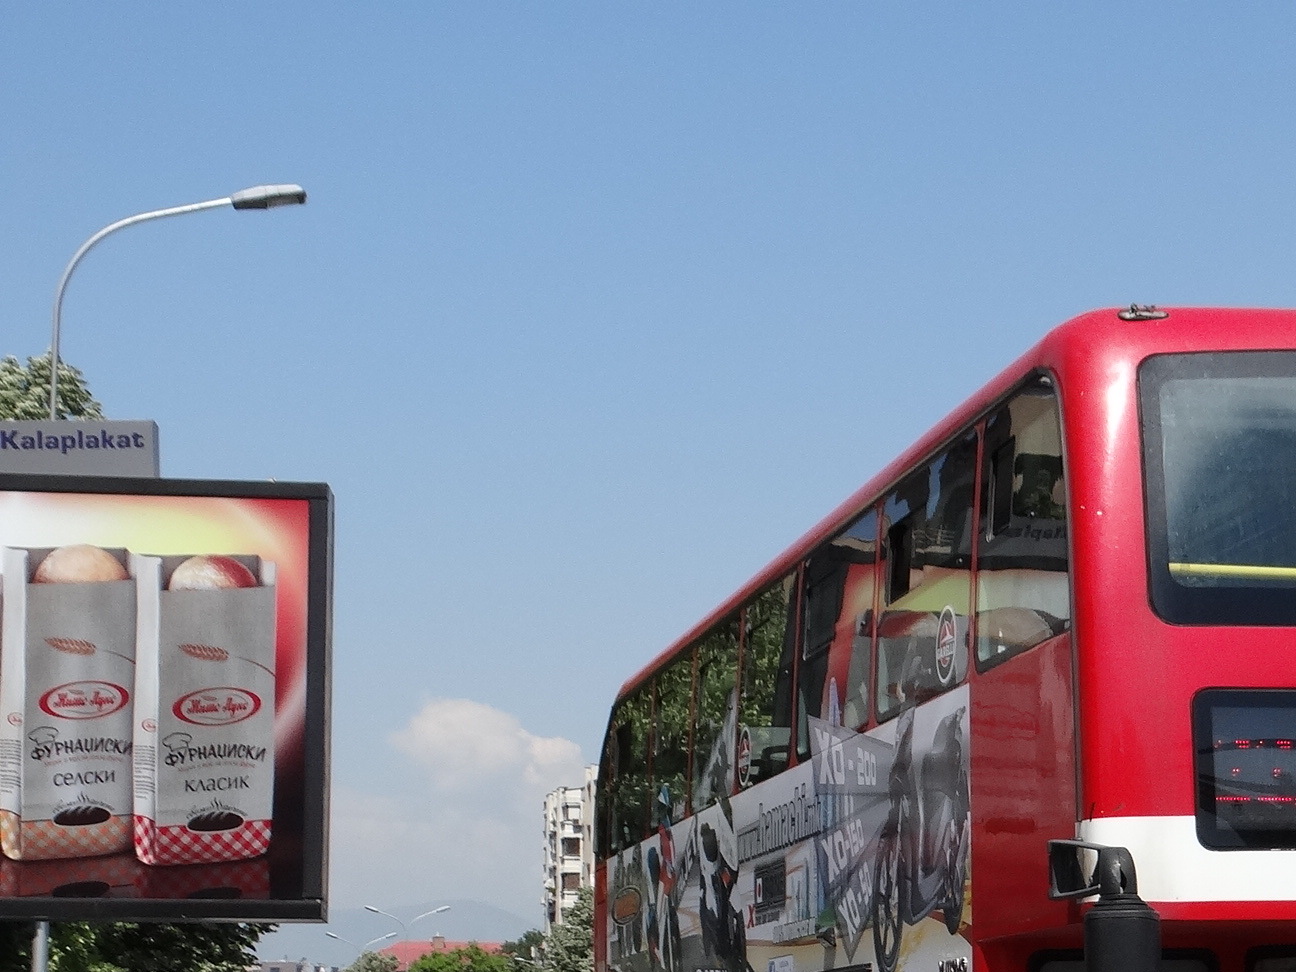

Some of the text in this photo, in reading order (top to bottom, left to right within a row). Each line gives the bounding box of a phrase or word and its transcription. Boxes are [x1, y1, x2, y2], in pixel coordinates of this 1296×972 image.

[0, 429, 144, 454] Kalaplakat
[857, 747, 877, 786] 200
[53, 770, 116, 787] селски
[184, 775, 250, 792] класик
